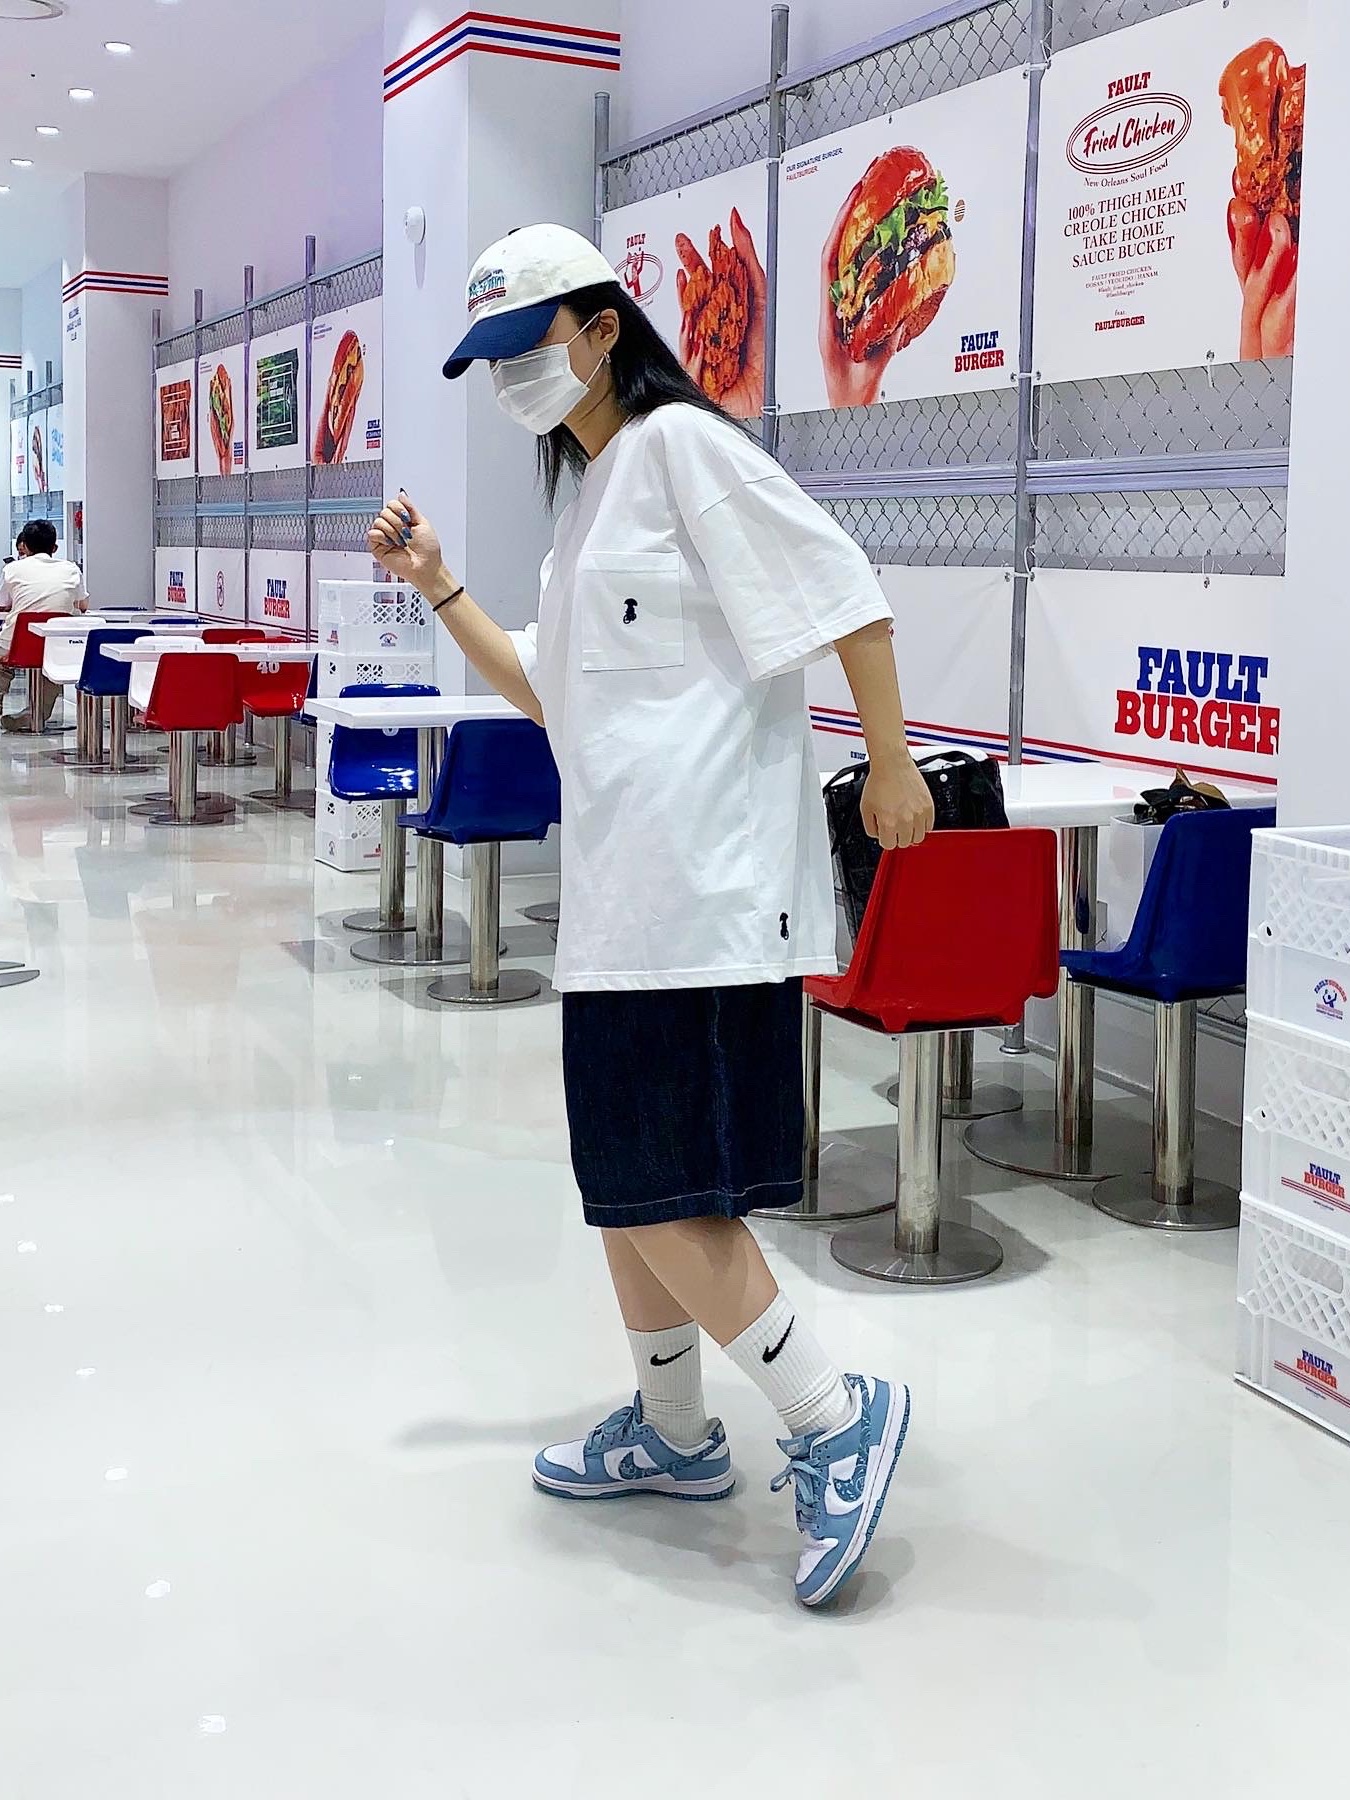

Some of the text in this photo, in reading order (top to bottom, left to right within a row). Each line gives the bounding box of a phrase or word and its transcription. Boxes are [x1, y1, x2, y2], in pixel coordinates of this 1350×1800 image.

[1107, 71, 1151, 99] FAULT
[1083, 112, 1176, 158] Fried Chicken
[1084, 157, 1168, 188] New Orleans Soul Food
[1068, 181, 1185, 220] 100% THIGH MEAT
[1063, 198, 1187, 237] CREOLE CHICKEN
[1083, 221, 1164, 250] TAKE HOME
[1072, 235, 1175, 268] SAUCE BUCKET
[960, 330, 999, 353] FAULT
[954, 349, 1004, 373] BURGER
[266, 578, 287, 599] FAULT
[264, 596, 290, 619] BURGER
[256, 660, 281, 674] 40
[1136, 646, 1269, 704] FAULT
[1114, 689, 1280, 756] BURGER
[1303, 1171, 1345, 1199] BURGER
[1309, 1162, 1341, 1185] FAULT
[1296, 1357, 1338, 1390] BURGER
[1301, 1349, 1333, 1375] FAULT
